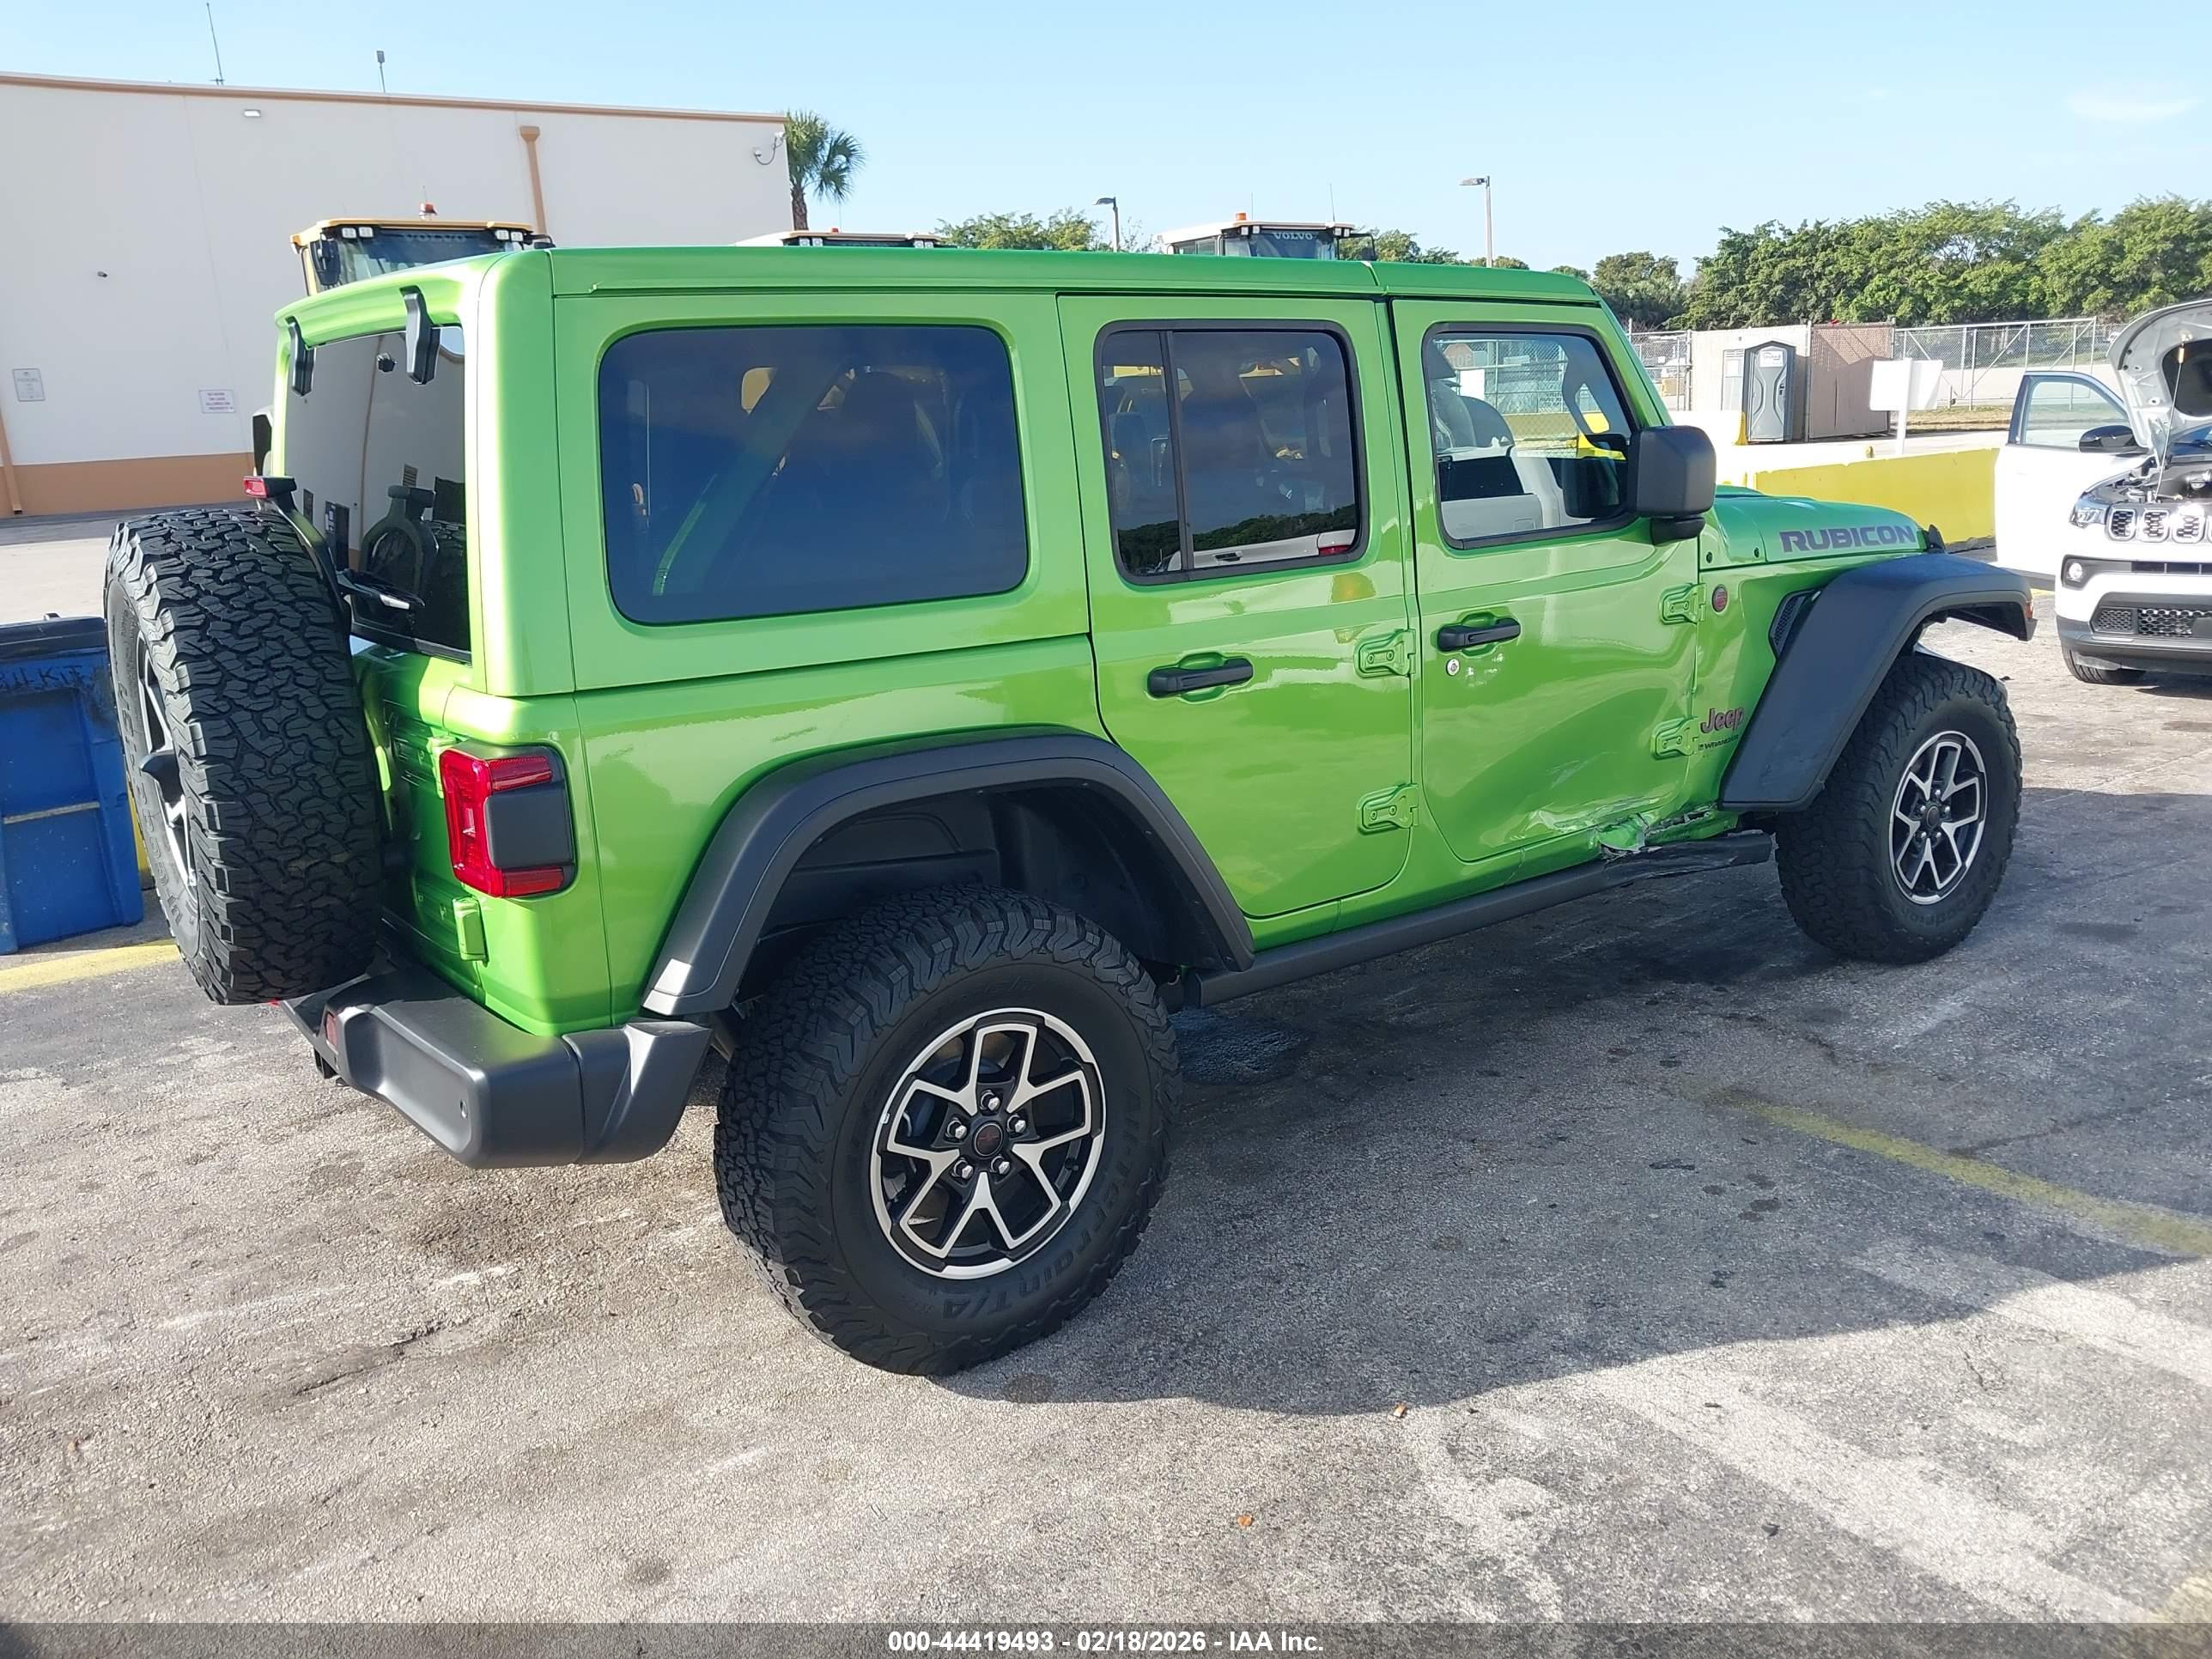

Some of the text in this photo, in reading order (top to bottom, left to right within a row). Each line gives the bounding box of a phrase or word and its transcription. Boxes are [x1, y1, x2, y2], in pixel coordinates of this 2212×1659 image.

[405, 233, 466, 242] VOLVO
[1272, 232, 1313, 240] VOLVO
[1779, 525, 1917, 553] RUBICON
[1700, 707, 1745, 733] Jeep
